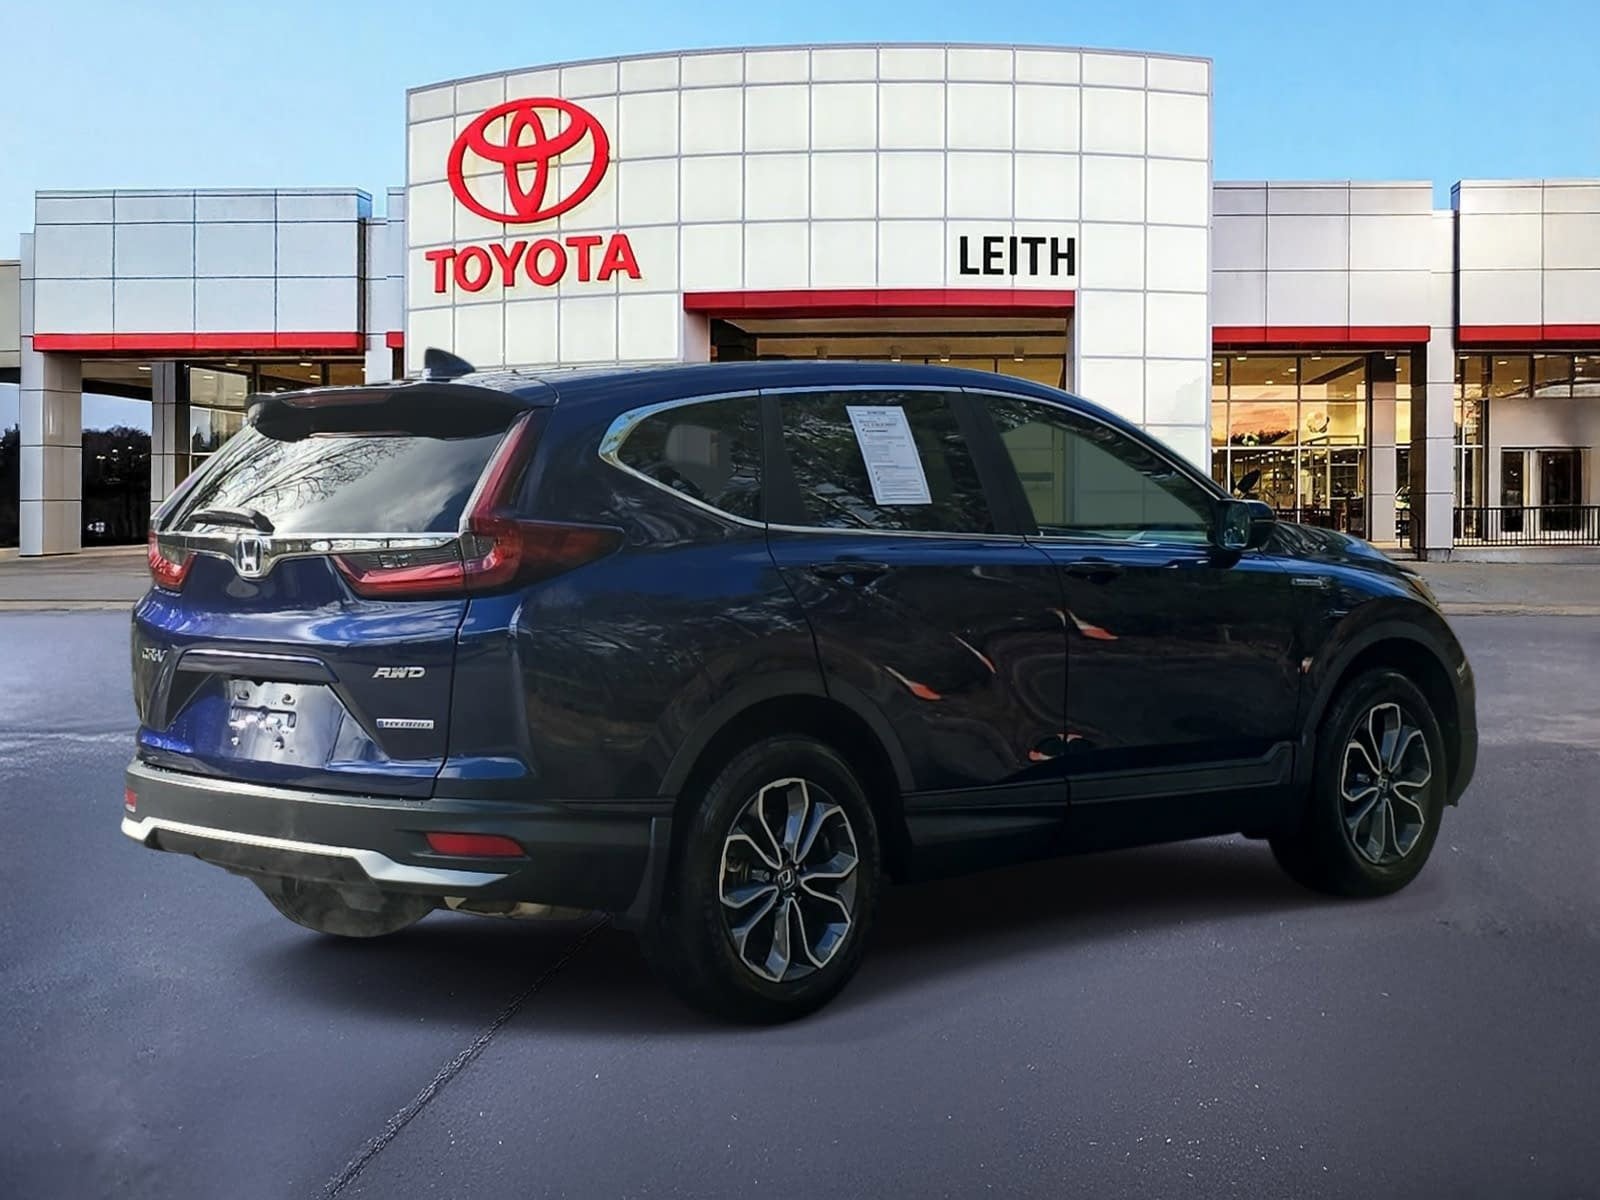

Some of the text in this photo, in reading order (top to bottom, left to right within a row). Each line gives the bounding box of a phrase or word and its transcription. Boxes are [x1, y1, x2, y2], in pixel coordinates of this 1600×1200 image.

[425, 234, 641, 293] TOYOTA
[960, 236, 1075, 276] LEITH
[372, 666, 426, 679] AWD
